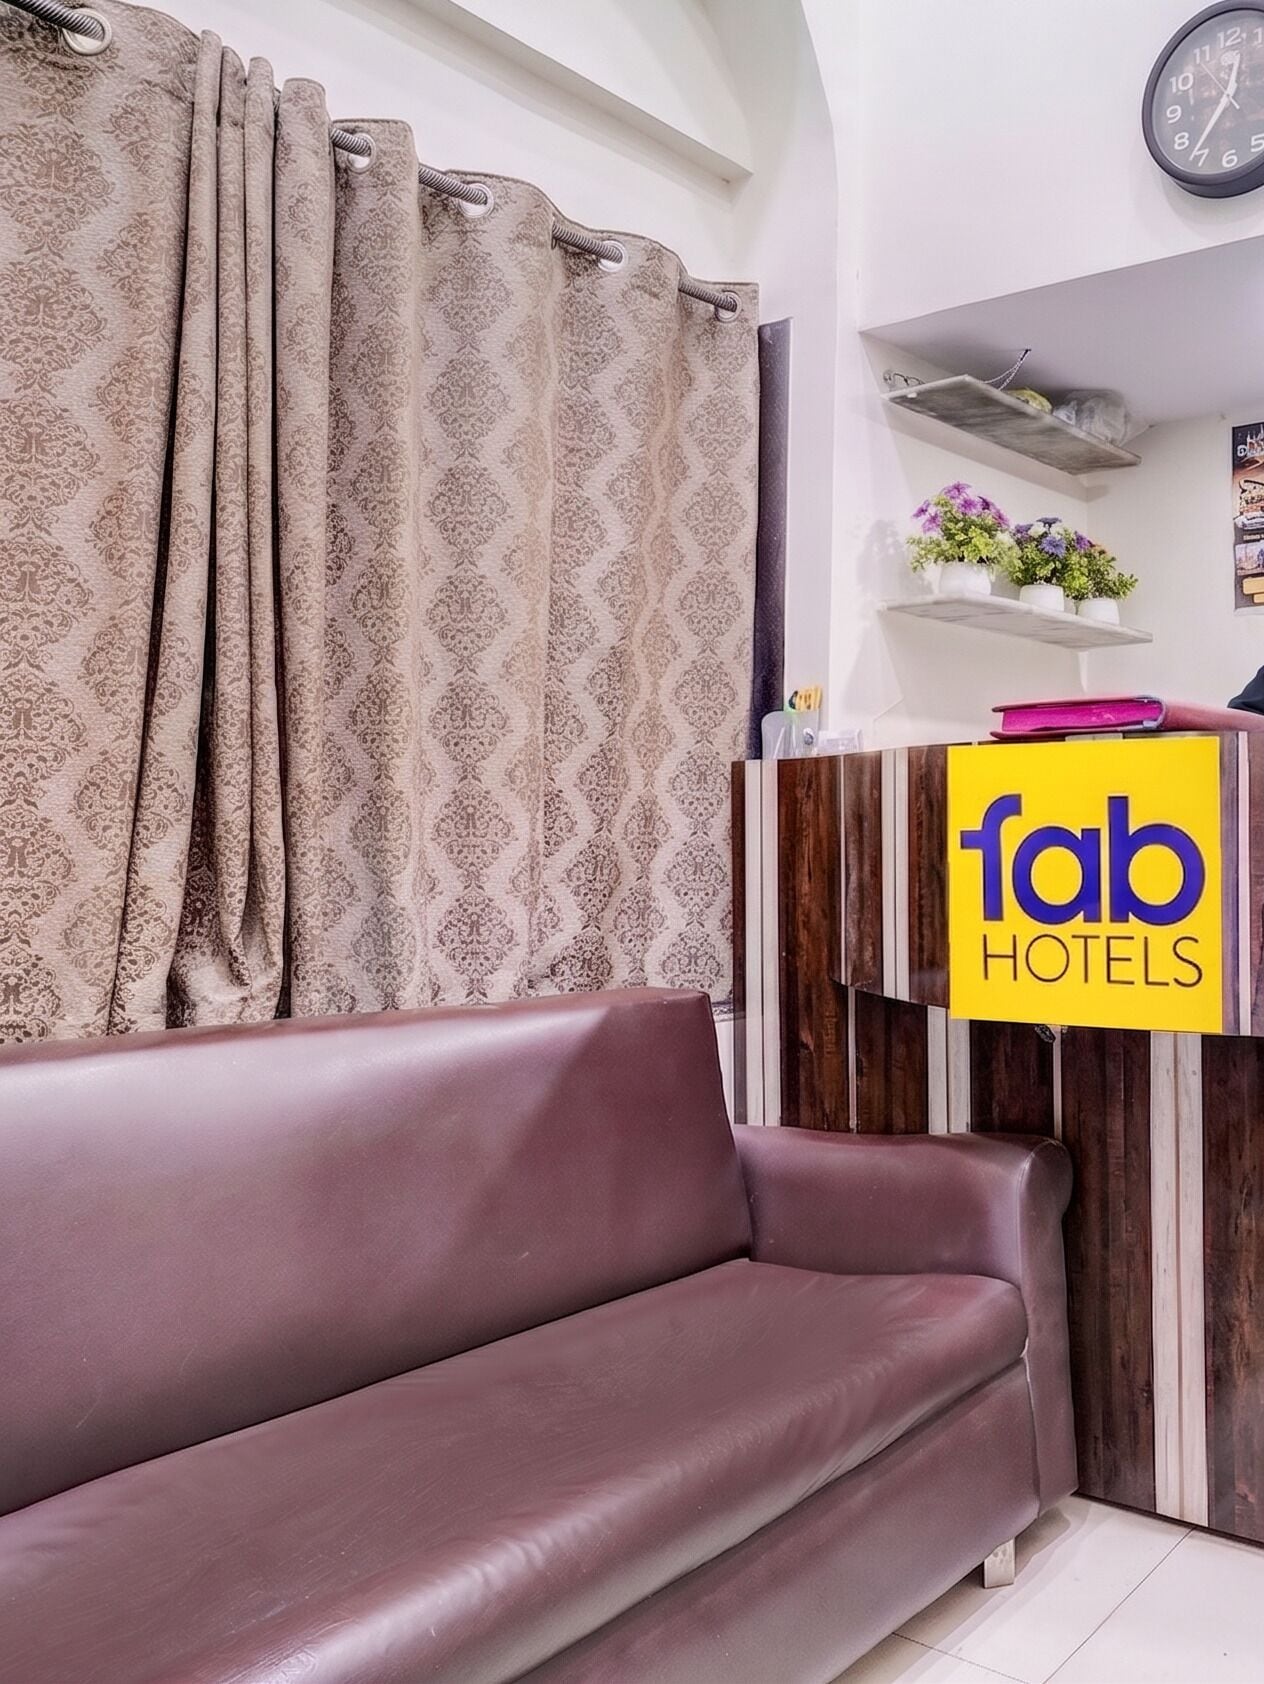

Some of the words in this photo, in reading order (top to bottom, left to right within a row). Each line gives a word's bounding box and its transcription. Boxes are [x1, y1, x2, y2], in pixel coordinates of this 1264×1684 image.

[1218, 27, 1242, 48] 12
[1254, 28, 1263, 44] 1
[1193, 45, 1211, 64] 11
[1170, 72, 1194, 93] 10
[1166, 105, 1182, 123] 9
[1174, 131, 1190, 151] 8
[1195, 149, 1209, 167] 7
[1222, 150, 1238, 168] 6
[960, 793, 1206, 926] fab
[982, 933, 1204, 988] HOTELS
